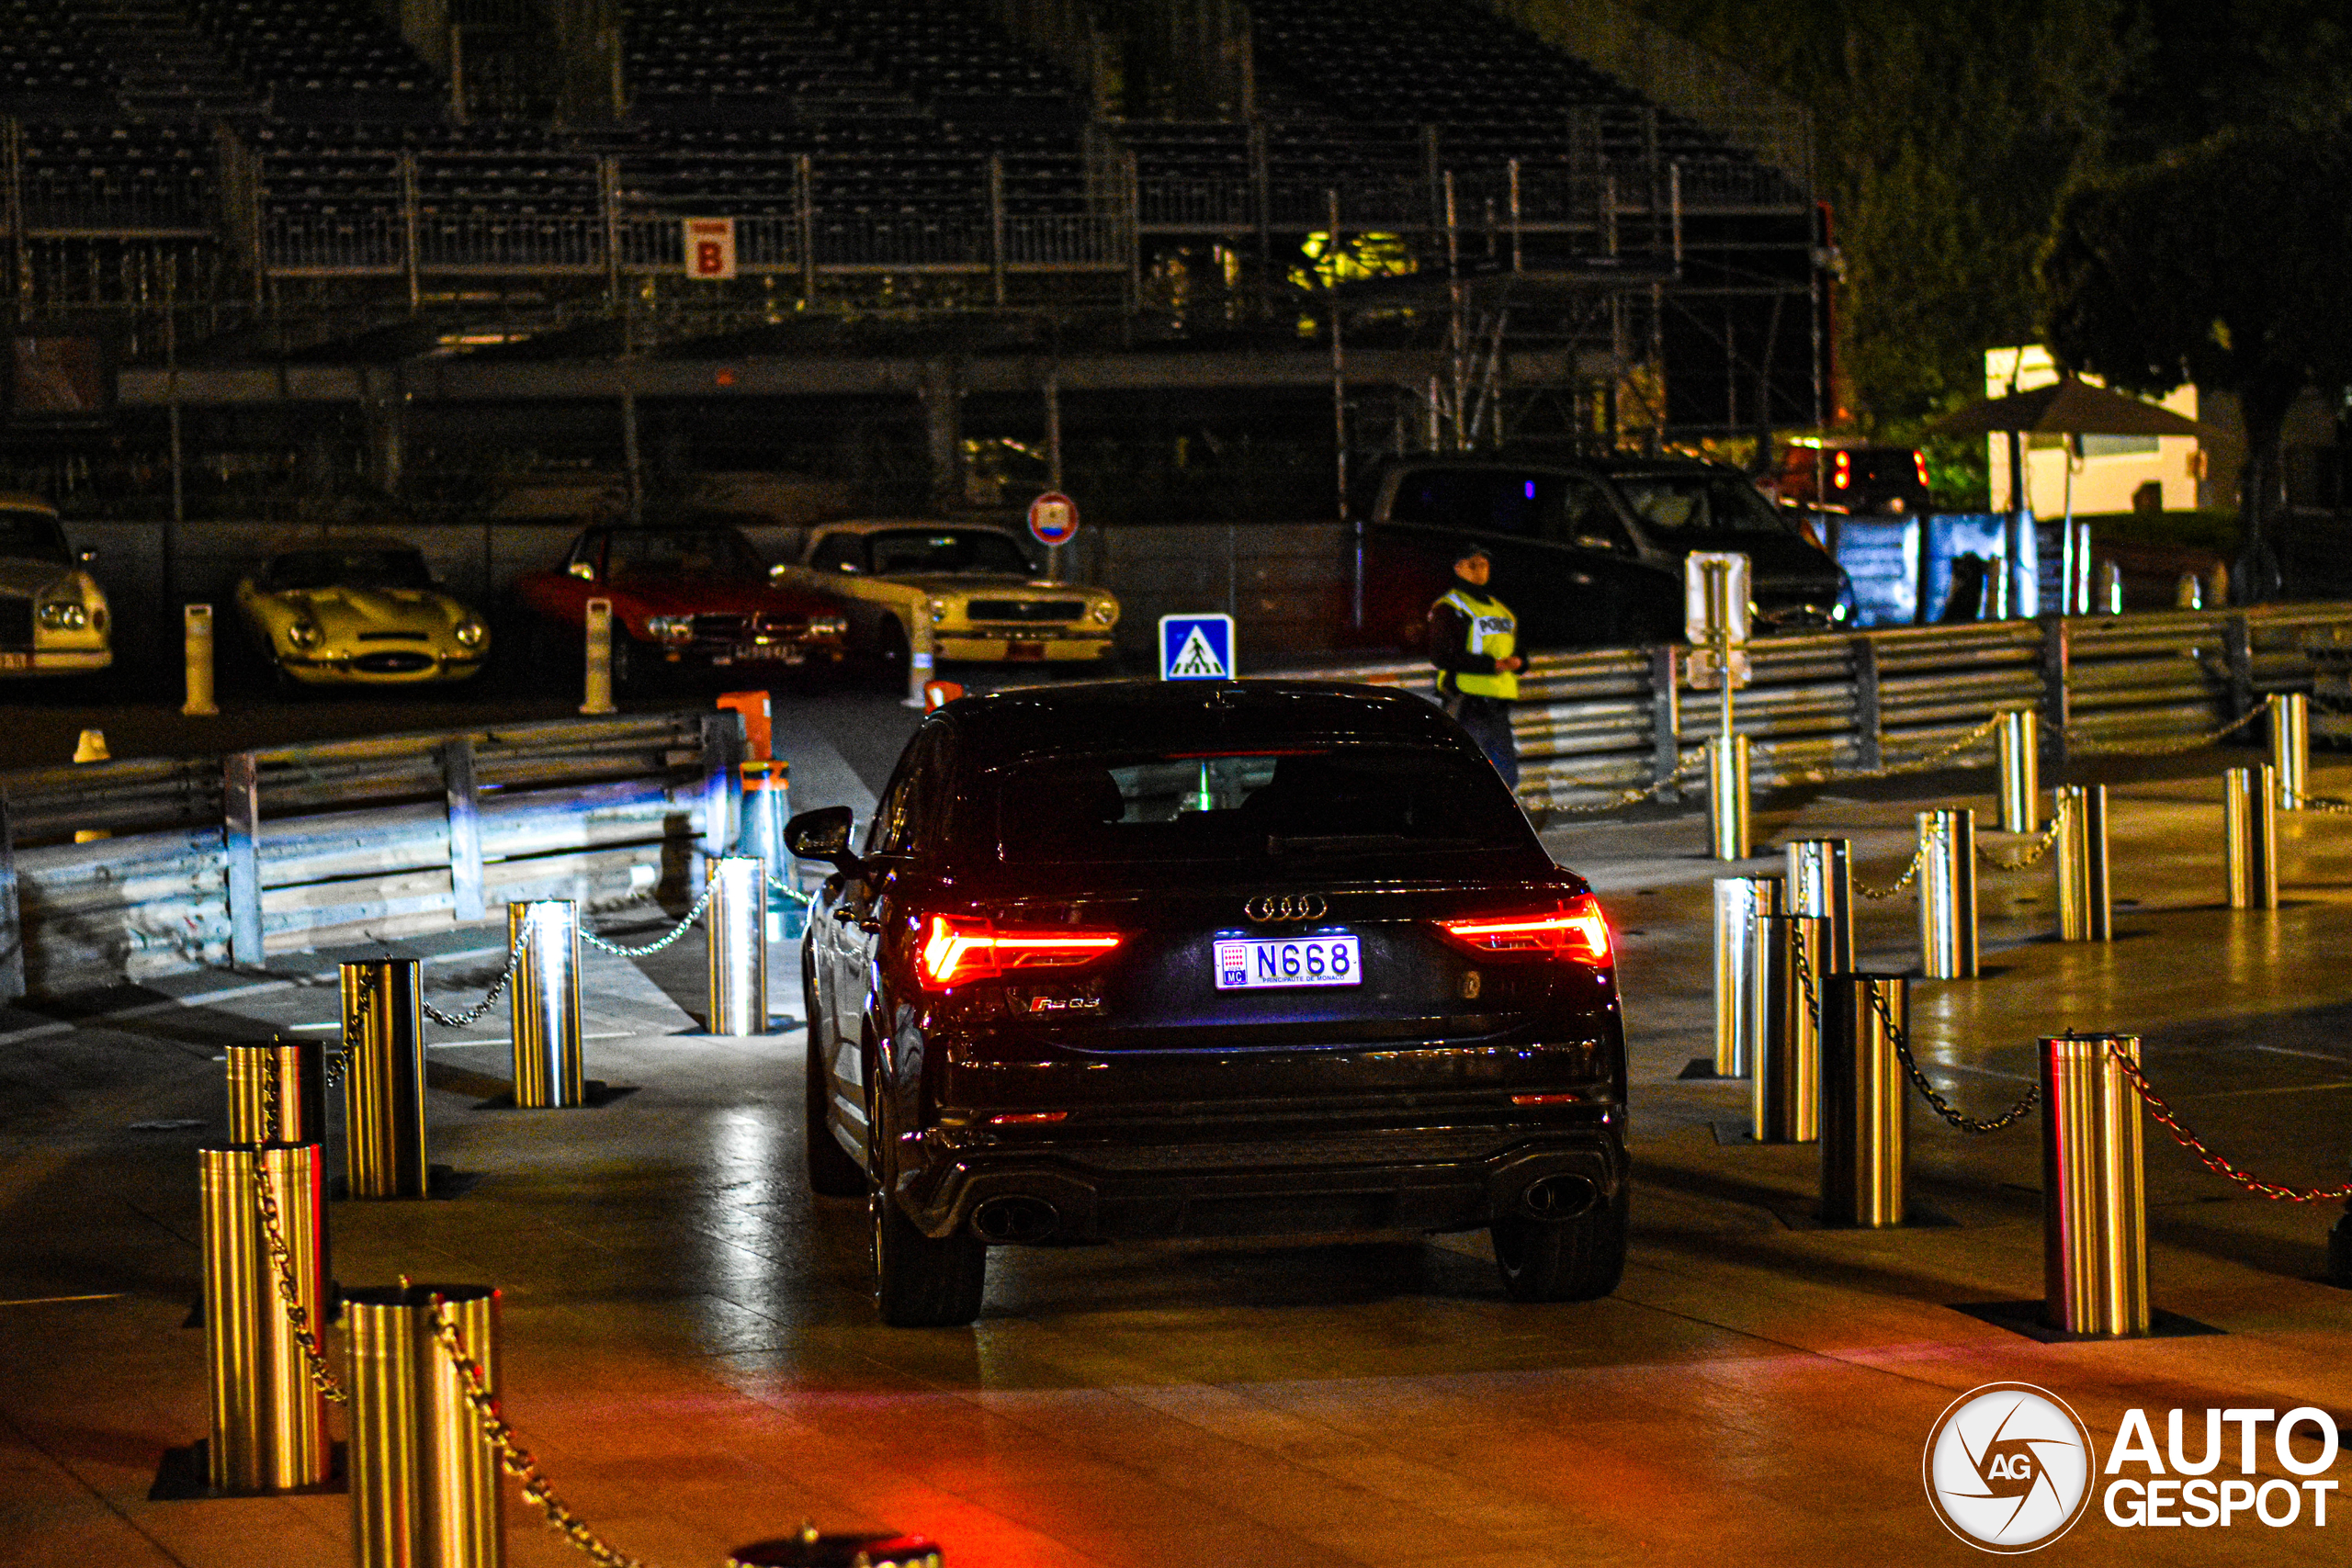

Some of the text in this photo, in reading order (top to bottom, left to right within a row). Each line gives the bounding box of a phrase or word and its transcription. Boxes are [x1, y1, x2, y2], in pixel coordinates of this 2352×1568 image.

[697, 241, 723, 275] B
[1257, 943, 1350, 976] N668
[1227, 972, 1242, 982] MC
